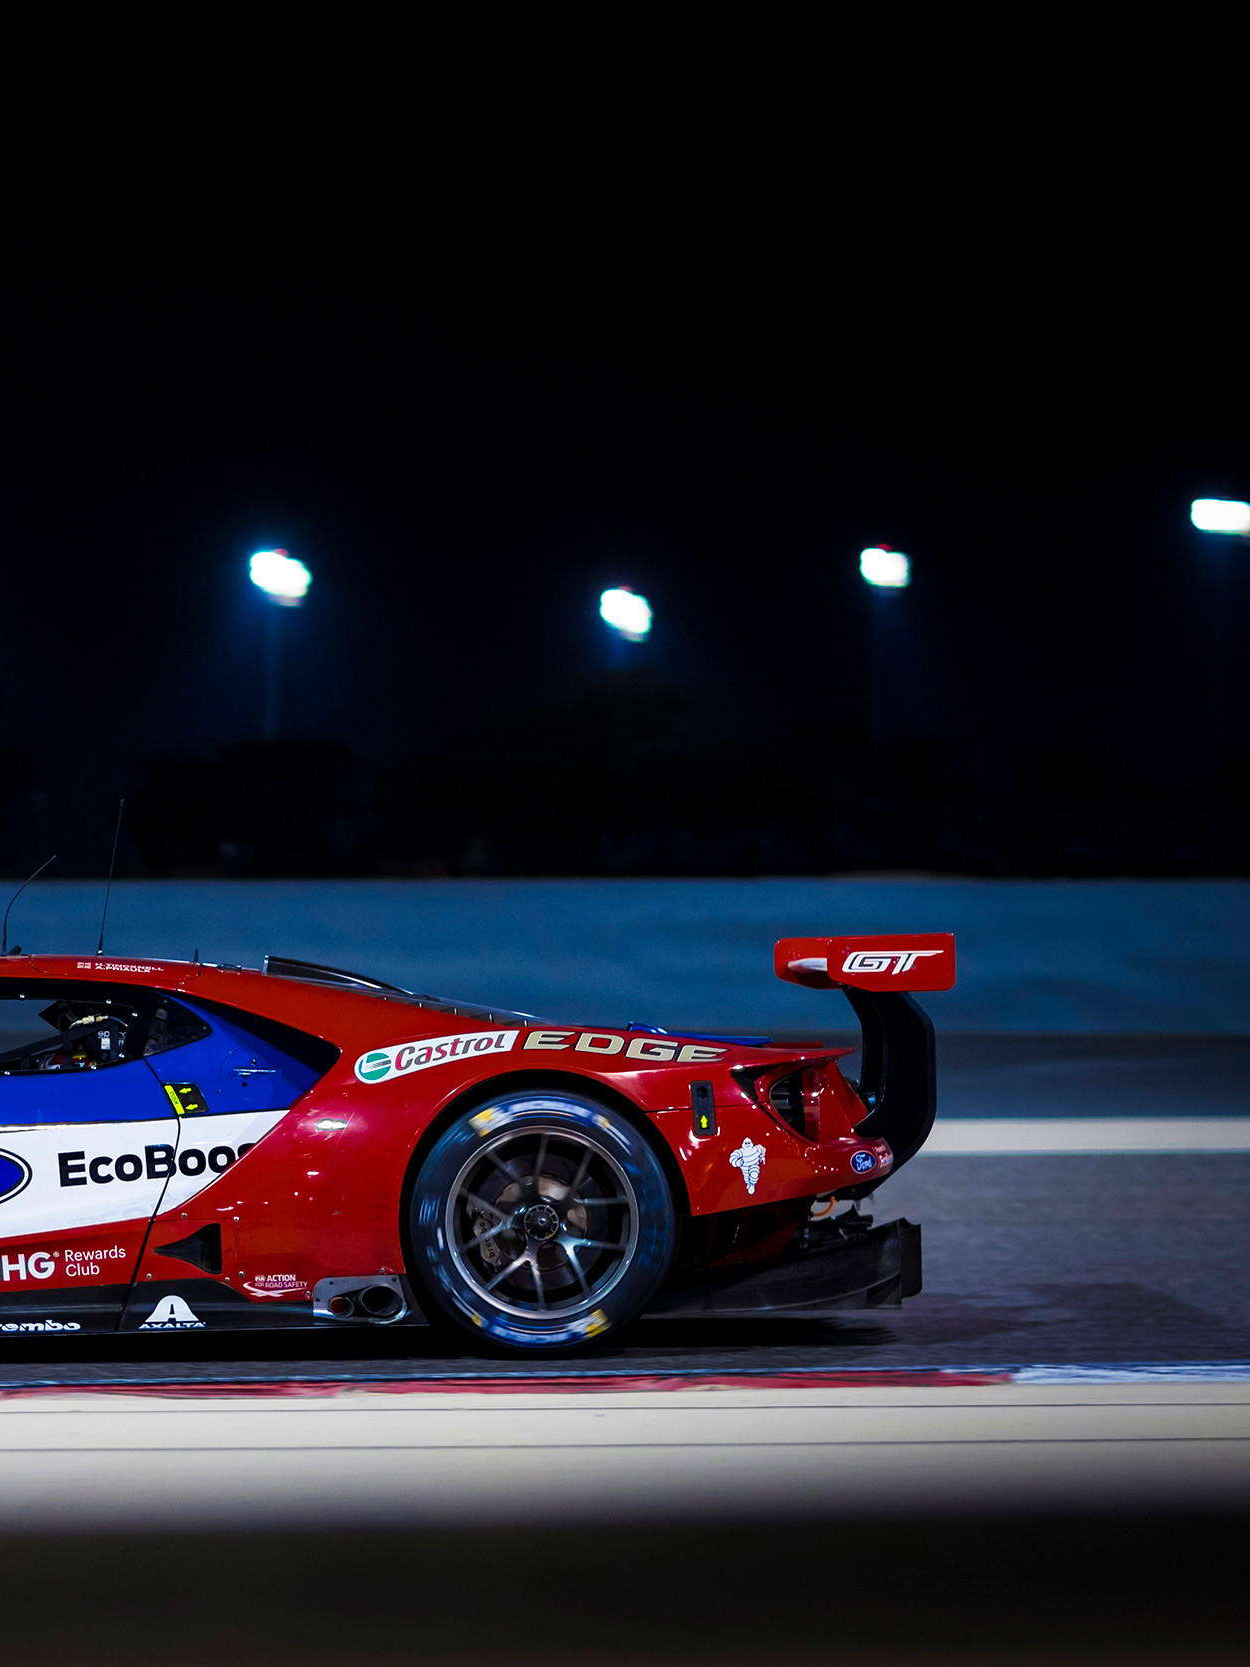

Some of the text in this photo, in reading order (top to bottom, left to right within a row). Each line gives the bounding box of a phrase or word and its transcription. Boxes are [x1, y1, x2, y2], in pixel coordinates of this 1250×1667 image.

[842, 950, 944, 975] GT
[394, 1030, 728, 1071] Castrol EDGE
[58, 1143, 256, 1188] EcoBoo
[64, 1245, 127, 1262] Rewards
[65, 1262, 101, 1277] Club
[266, 1274, 296, 1282] ACTION
[284, 1280, 308, 1288] SAFETY
[138, 1322, 206, 1330] AXALTA
